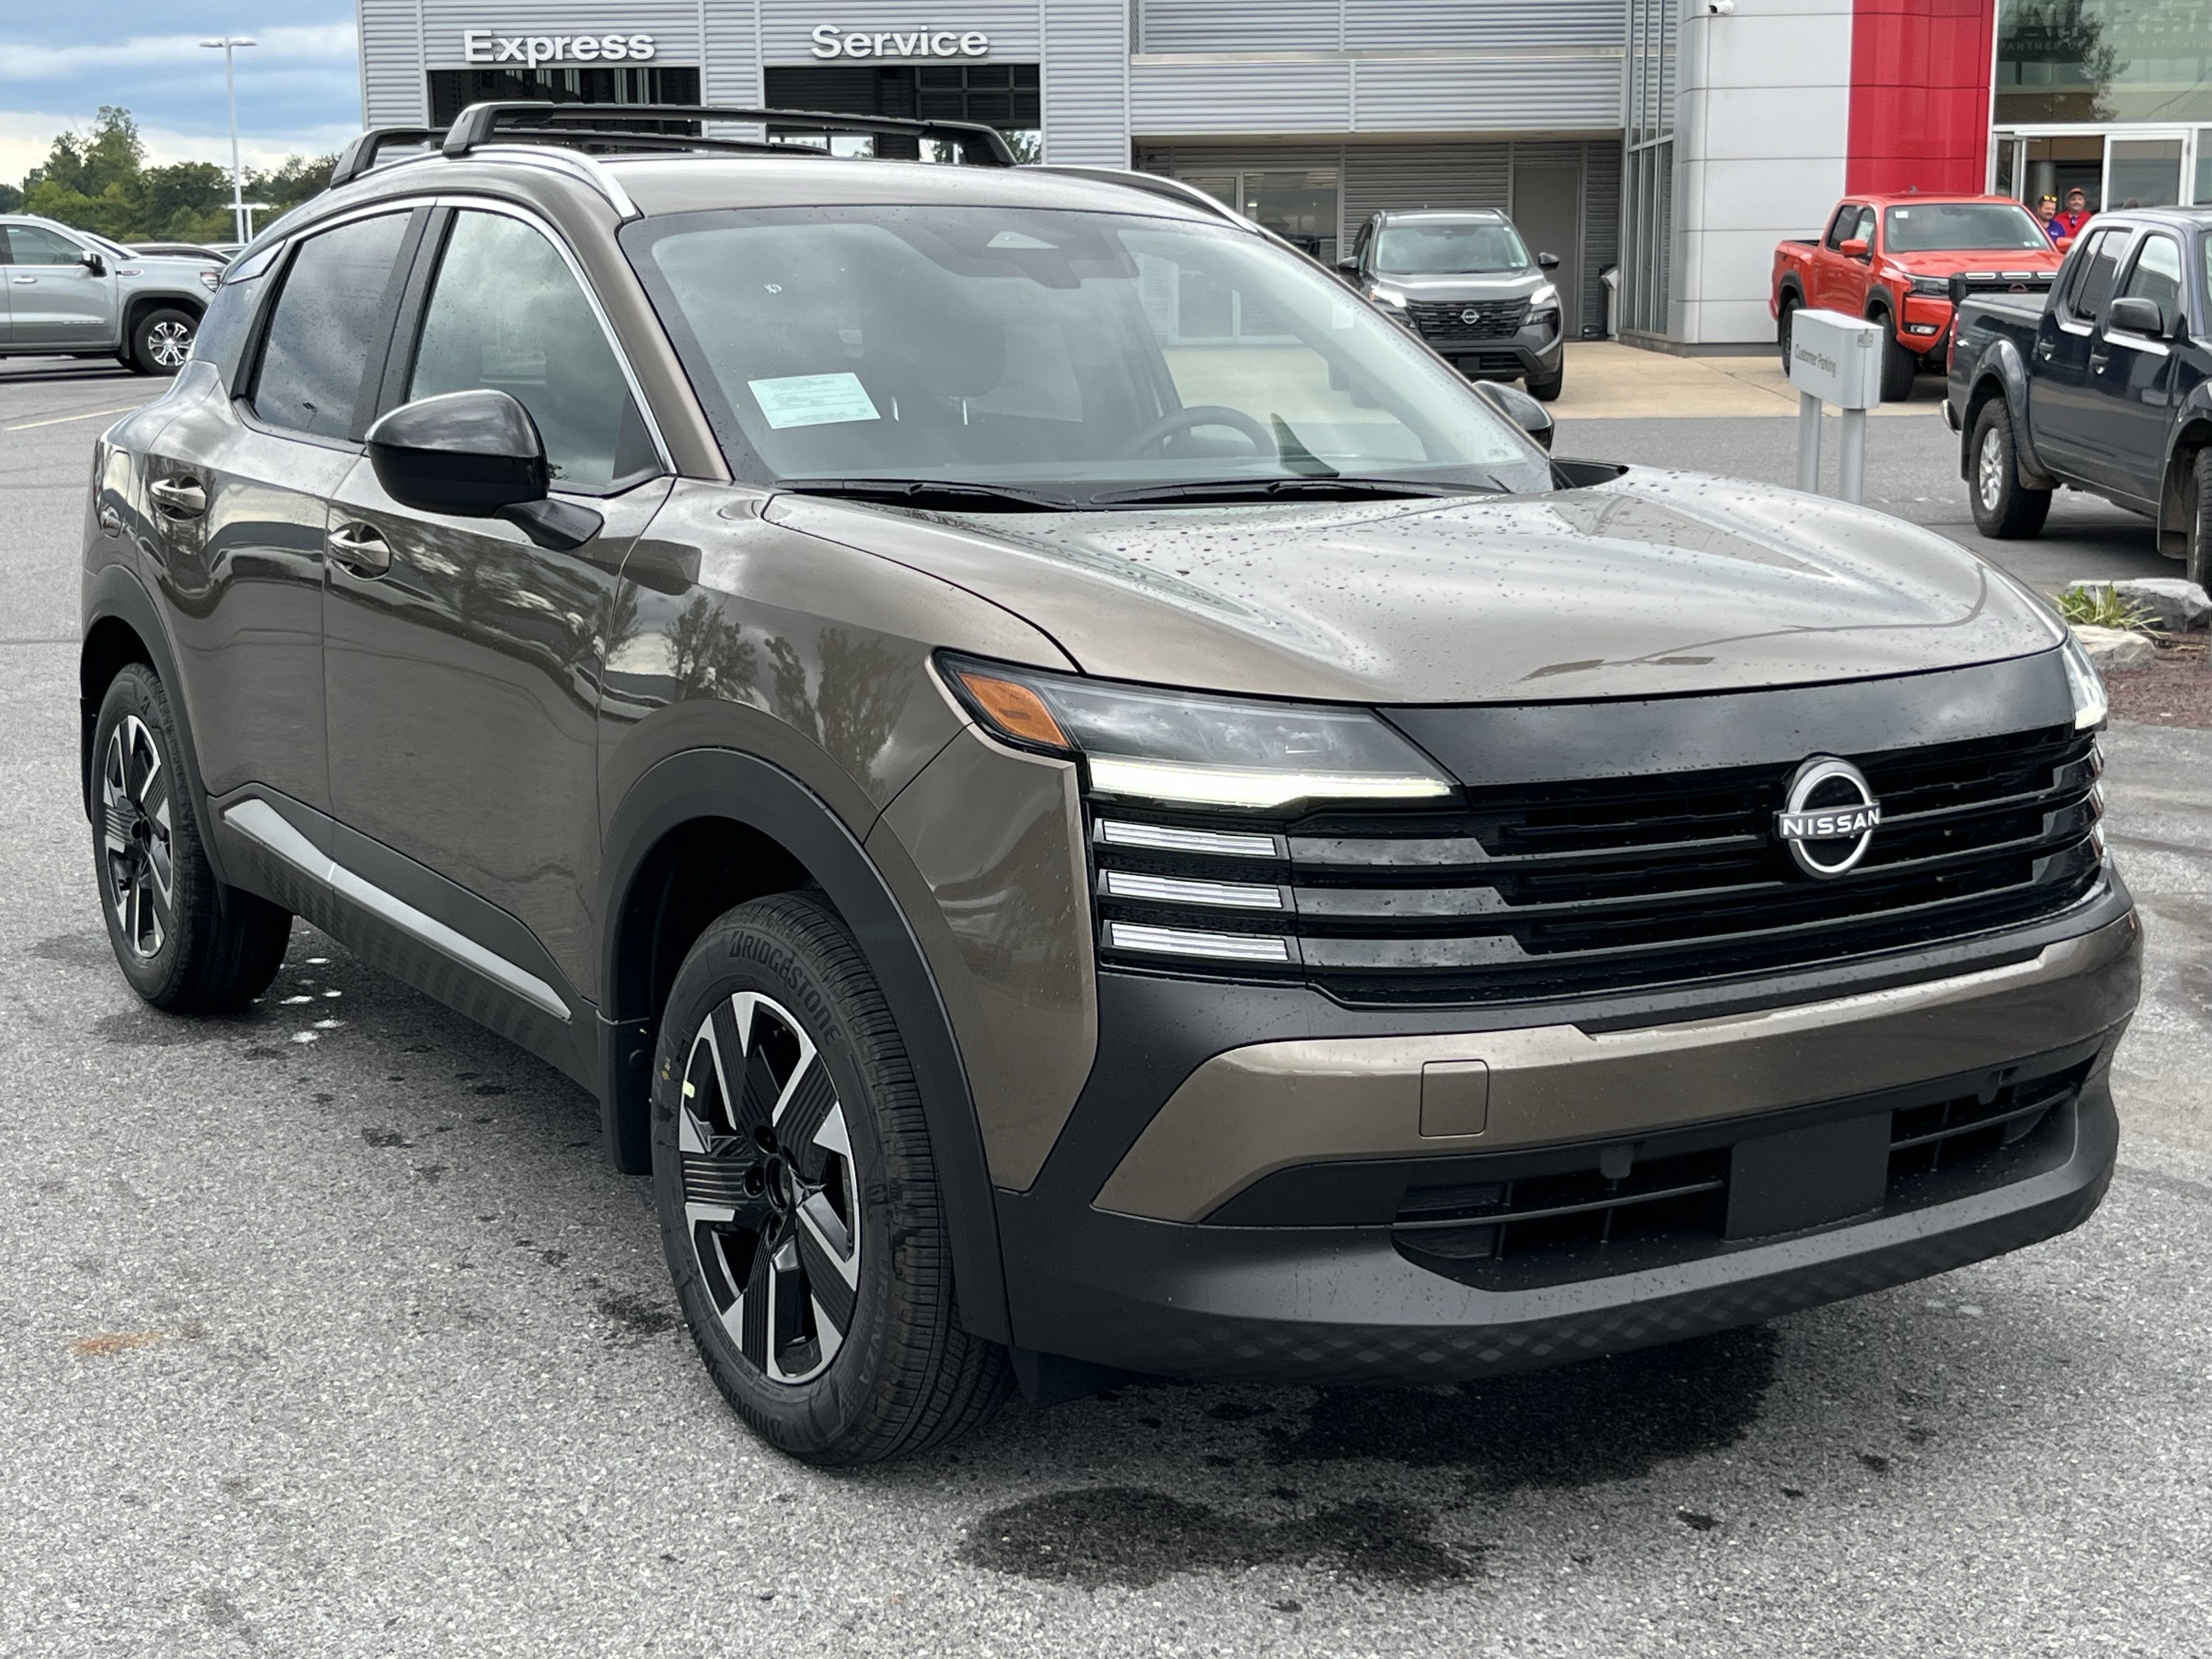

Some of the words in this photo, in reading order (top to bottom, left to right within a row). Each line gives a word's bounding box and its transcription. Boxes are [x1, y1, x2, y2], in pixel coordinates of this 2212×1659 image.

[464, 30, 656, 68] Express
[811, 24, 989, 58] Service
[1796, 344, 1817, 365] Customer
[1818, 353, 1836, 378] Parking
[1782, 808, 1881, 836] NISSAN
[729, 930, 842, 1046] BRIDGESTONE
